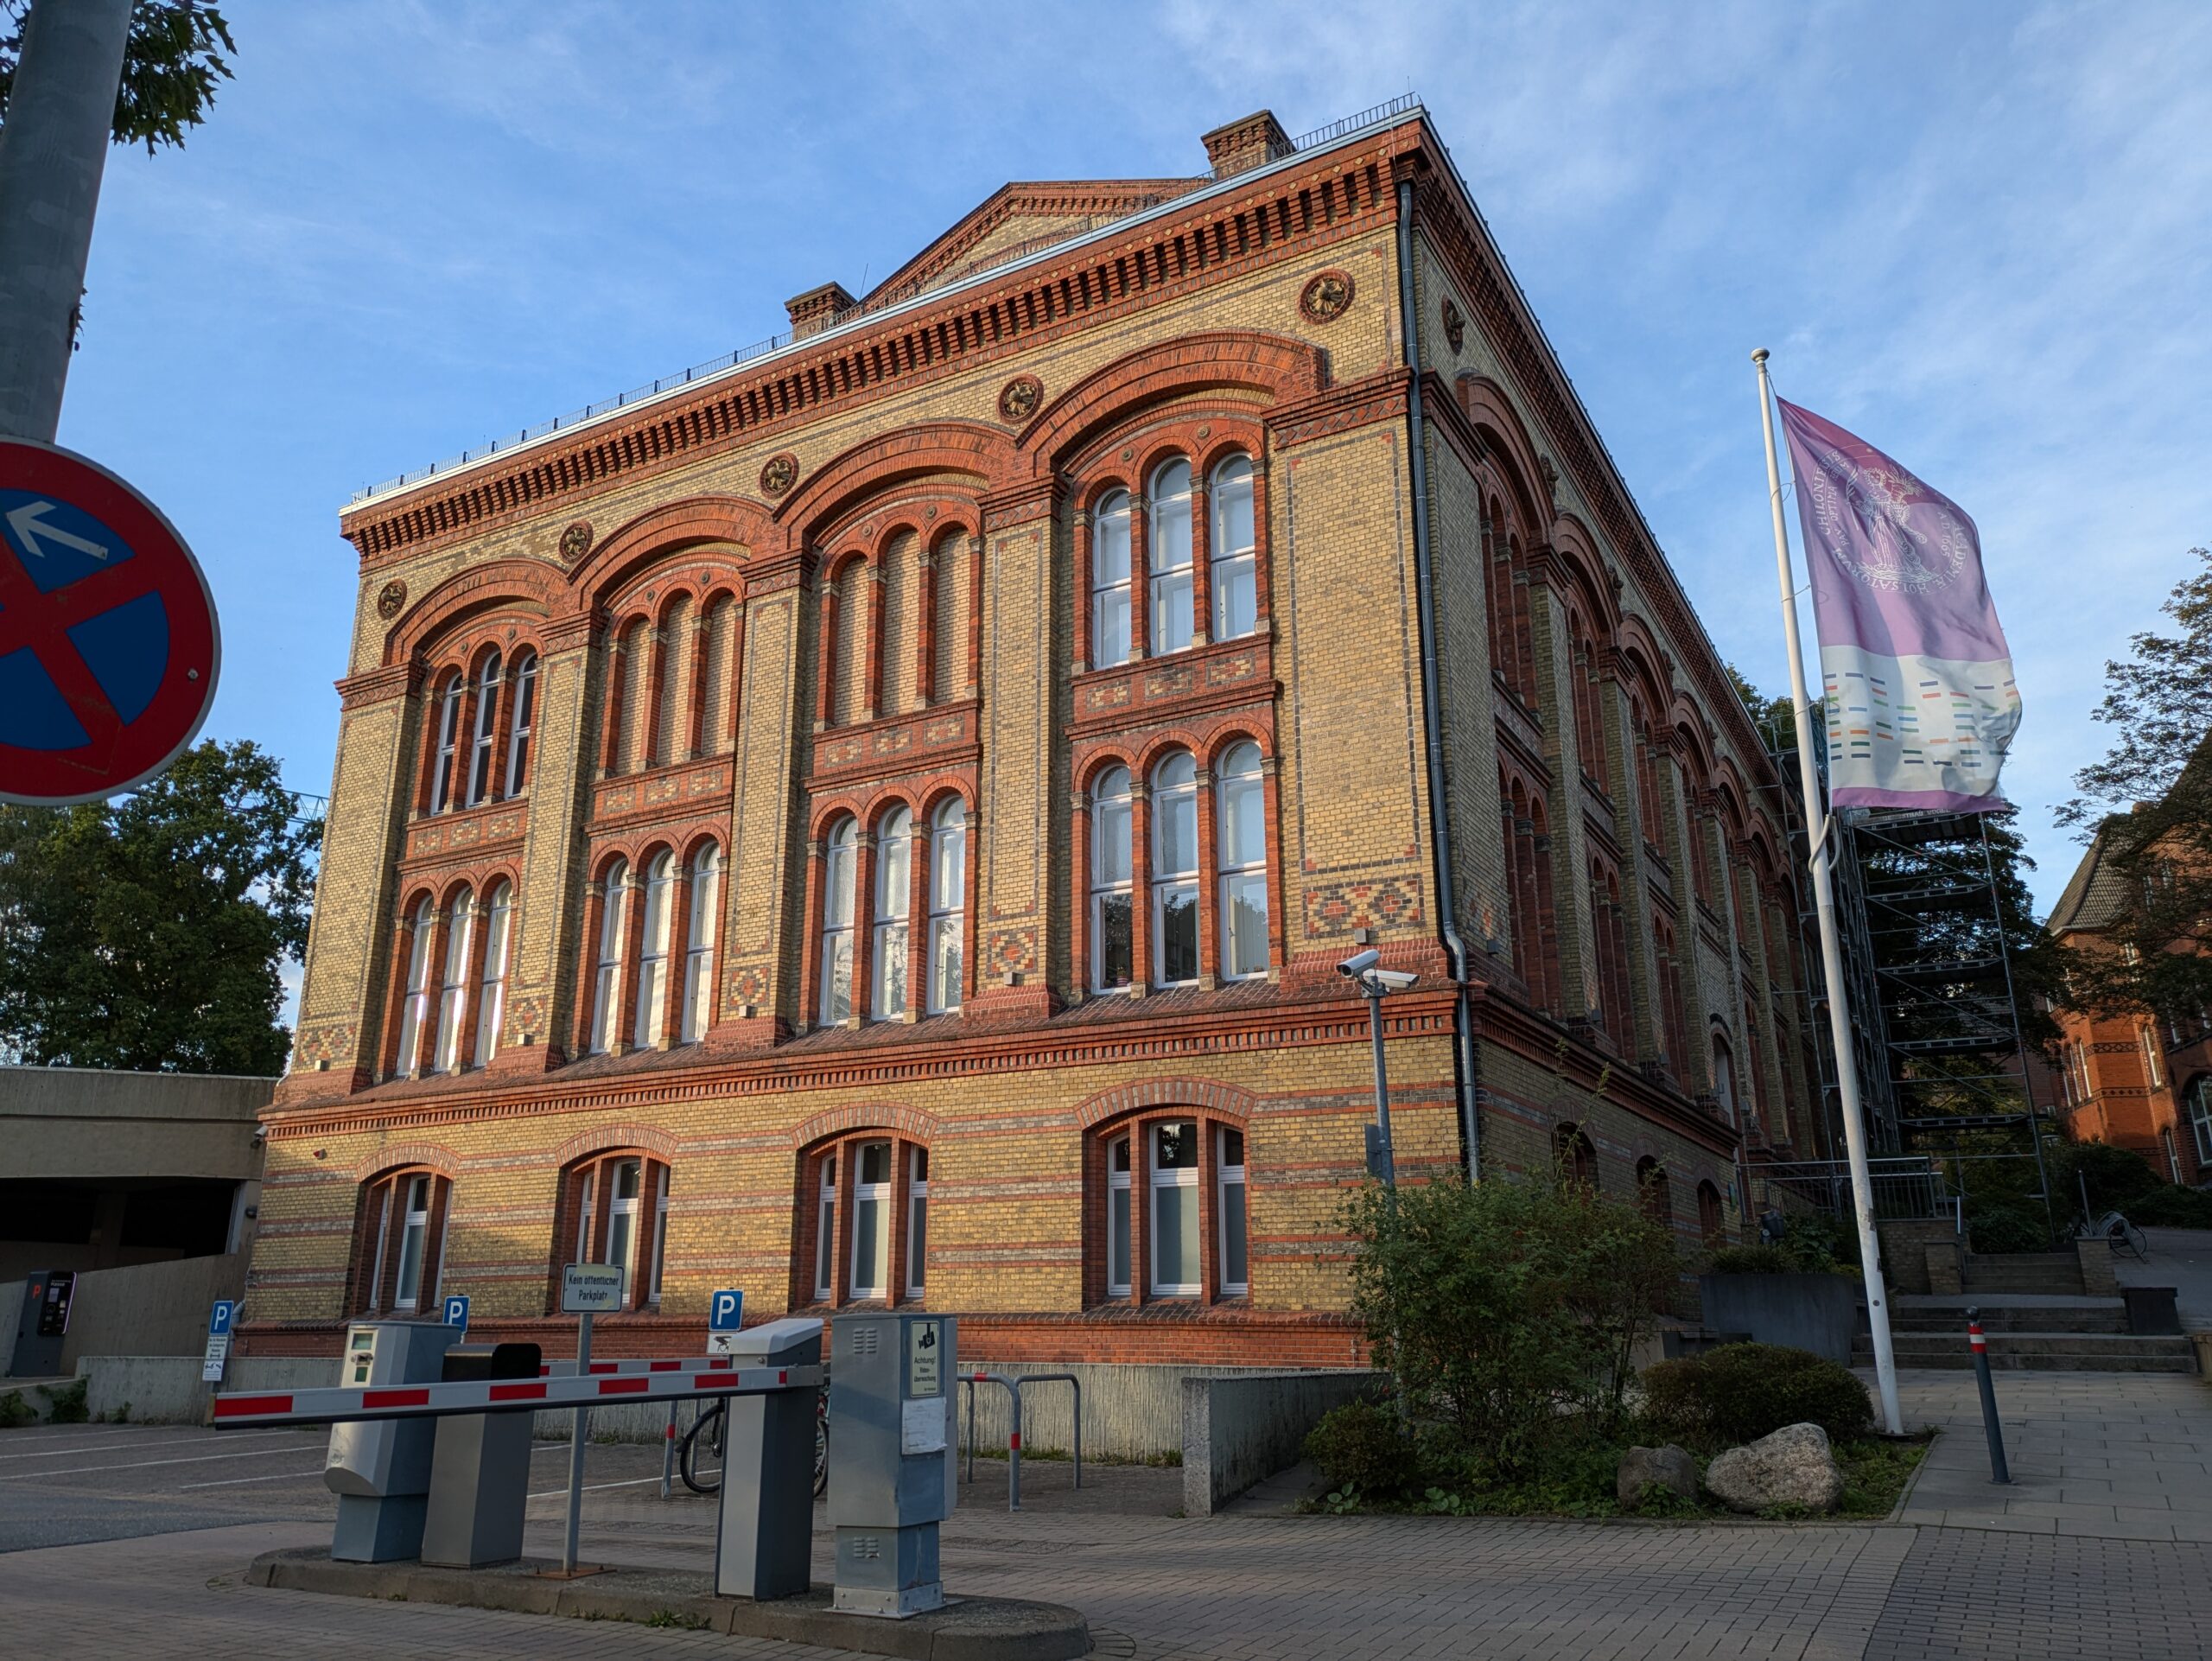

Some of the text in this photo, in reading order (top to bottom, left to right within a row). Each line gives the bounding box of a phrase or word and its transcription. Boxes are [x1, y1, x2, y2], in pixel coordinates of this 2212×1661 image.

[1941, 534, 1952, 557] 1665
[569, 1274, 583, 1286] Kein
[578, 1289, 608, 1303] Parkplatz
[214, 1305, 228, 1331] P
[448, 1301, 463, 1325] P
[717, 1295, 735, 1326] P
[914, 1356, 937, 1365] Achtung!
